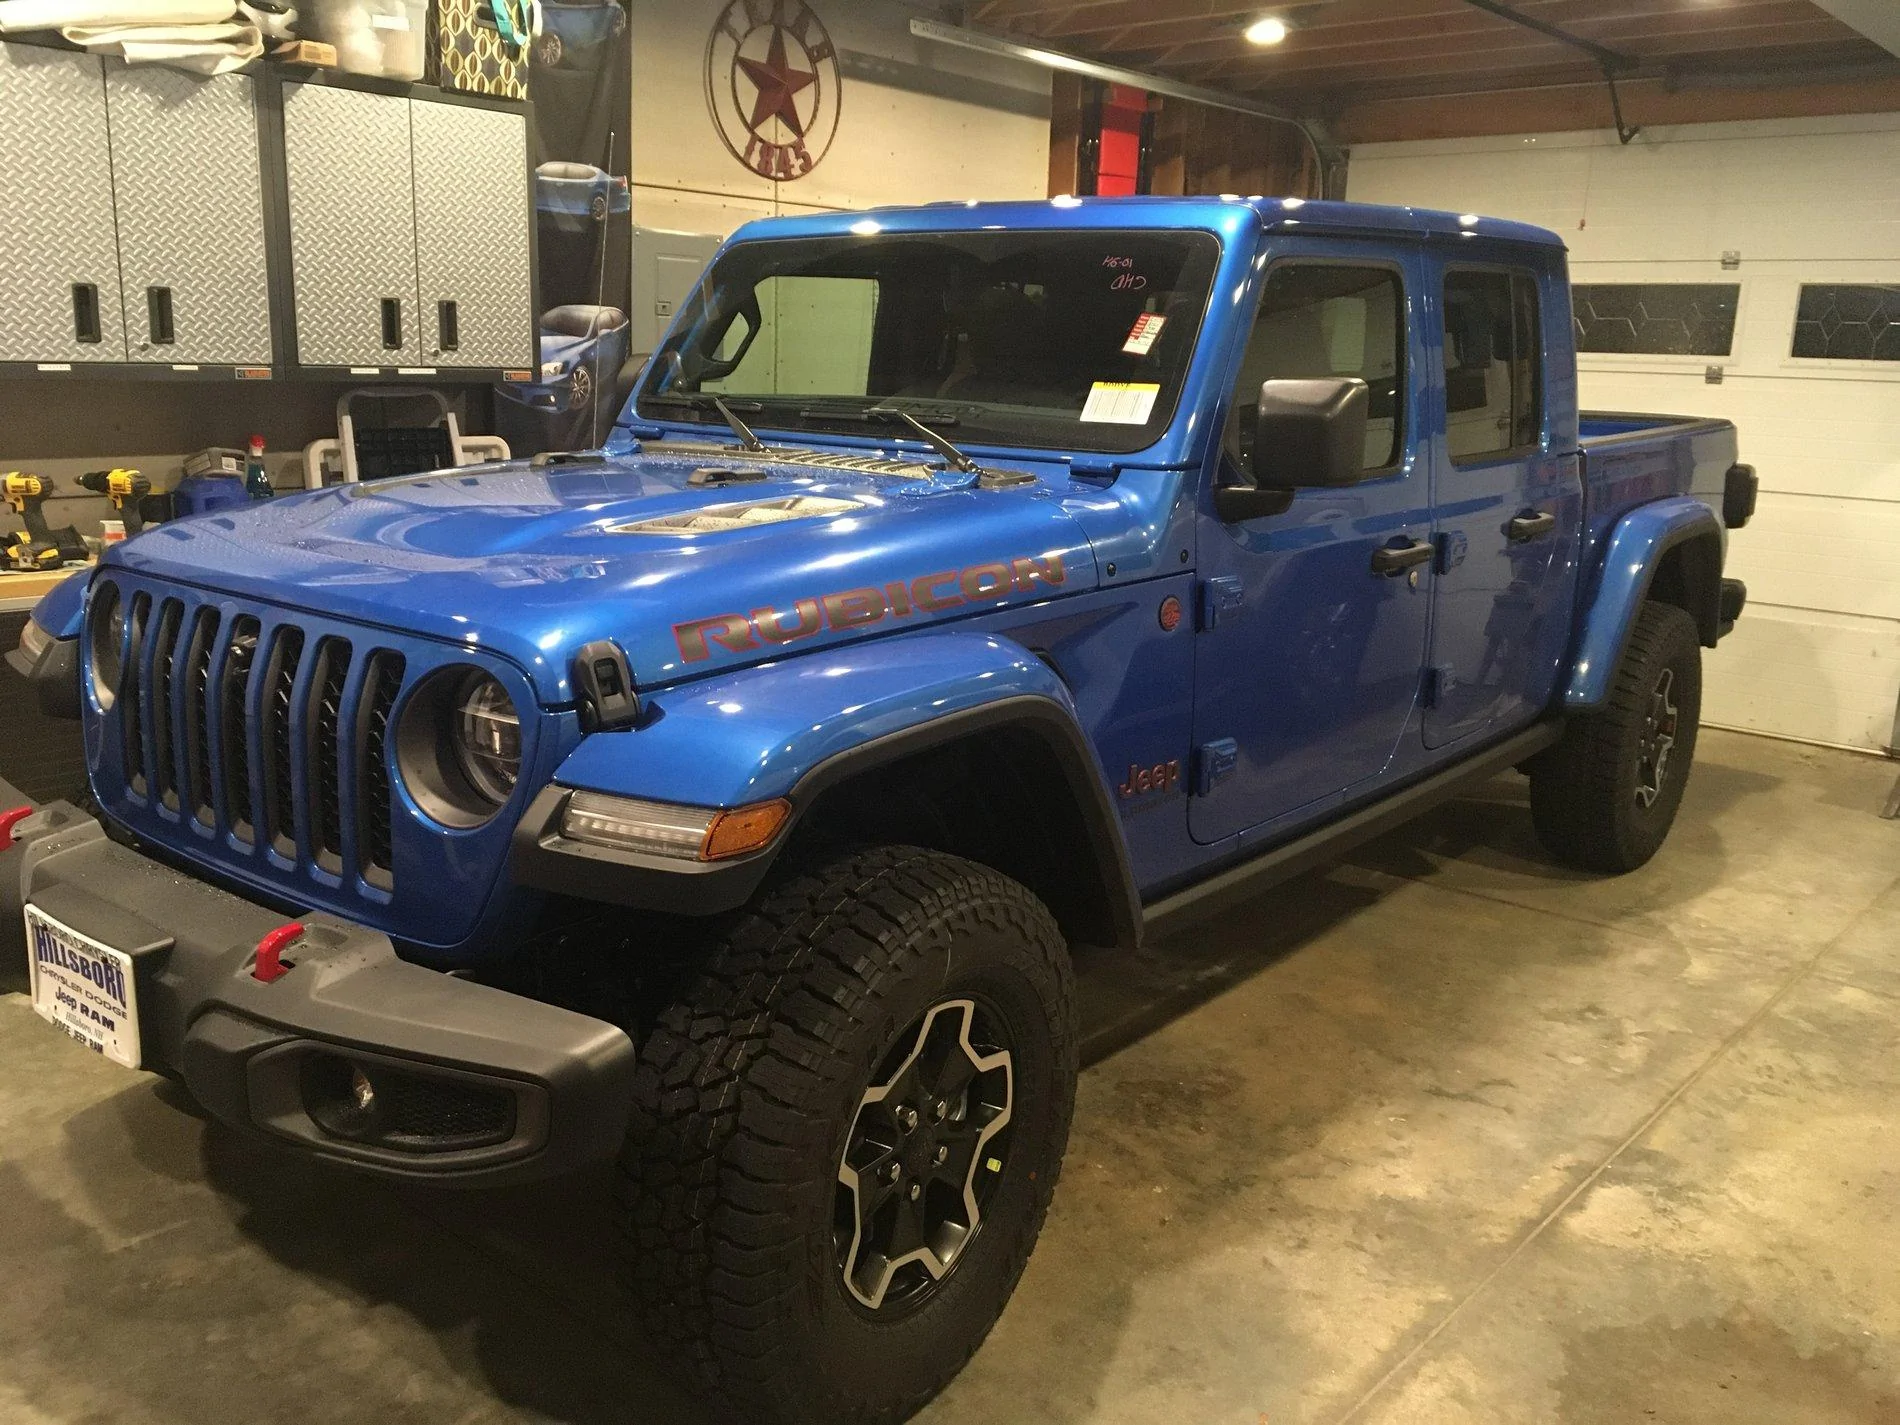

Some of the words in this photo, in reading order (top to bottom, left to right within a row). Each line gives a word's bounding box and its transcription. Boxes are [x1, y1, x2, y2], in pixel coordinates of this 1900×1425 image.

[672, 555, 1066, 664] RUBICON
[1119, 759, 1180, 800] Jeep
[39, 965, 83, 995] CHRYSLER
[84, 989, 128, 1020] DODGE
[55, 986, 78, 1011] Jeep
[80, 1003, 115, 1032] RAM
